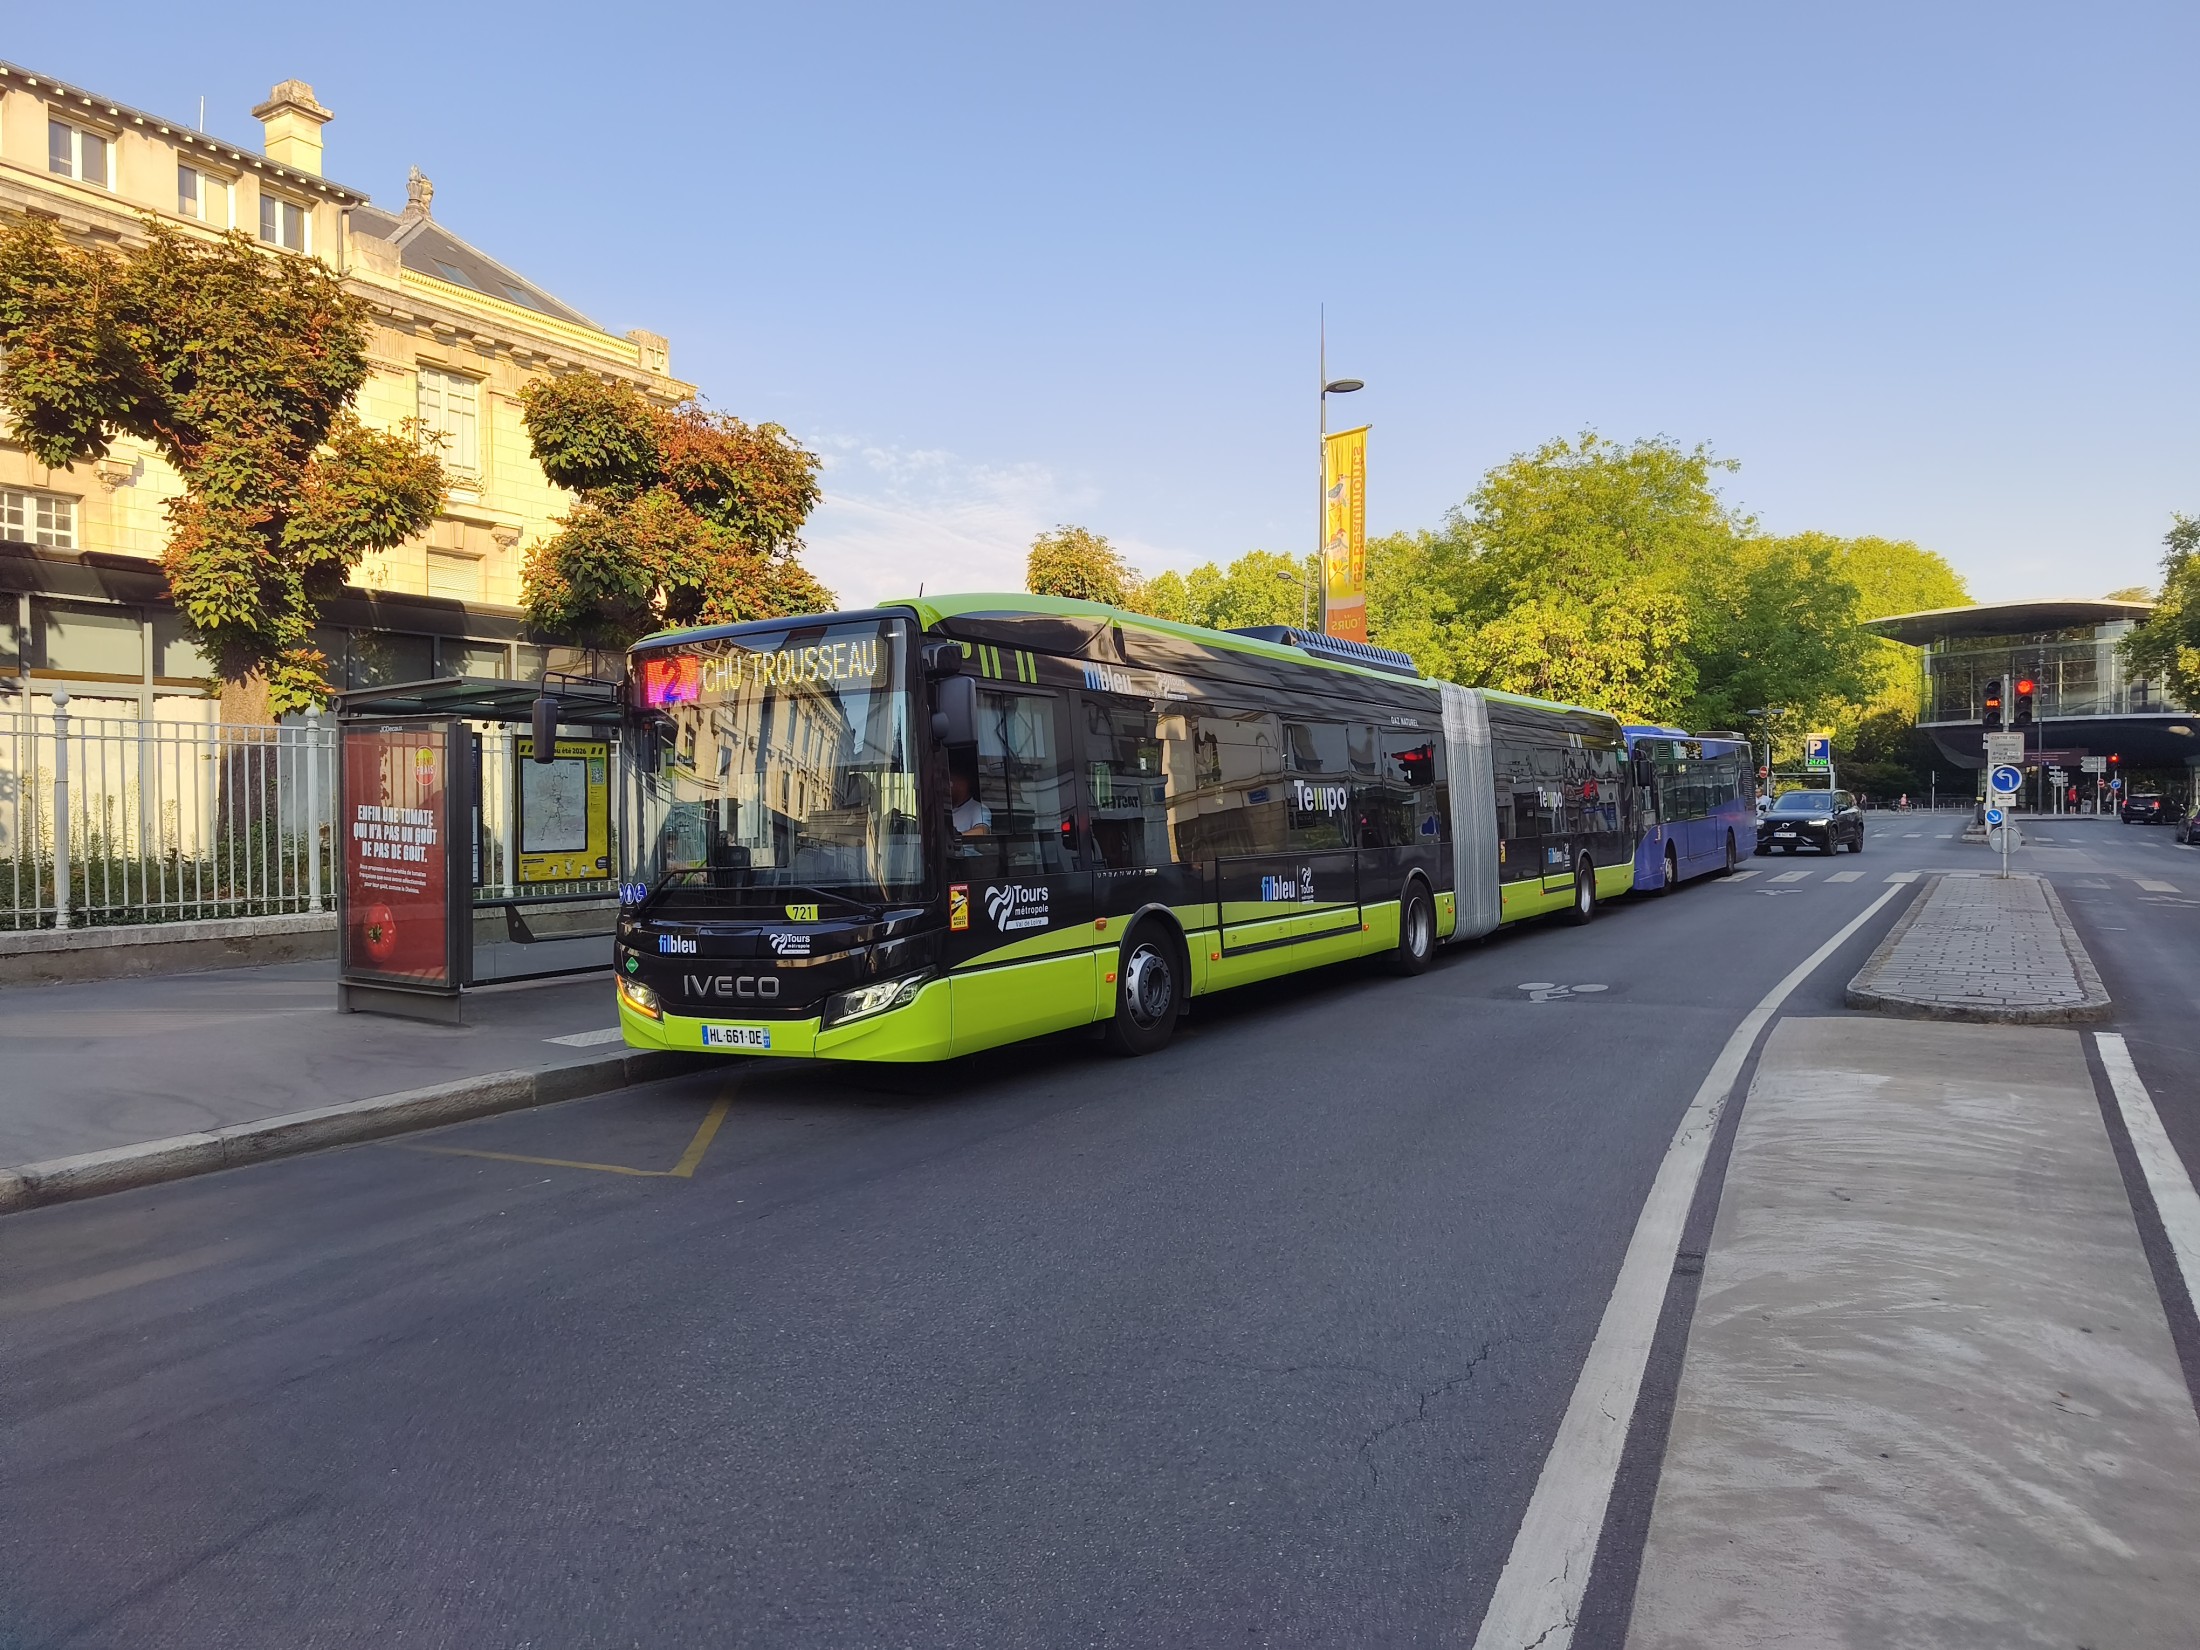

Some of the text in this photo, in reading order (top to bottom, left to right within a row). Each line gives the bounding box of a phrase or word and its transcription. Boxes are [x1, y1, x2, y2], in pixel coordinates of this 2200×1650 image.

[661, 639, 878, 701] 2 CHU TROUSSEAU
[572, 747, 587, 755] 2026
[1809, 740, 1822, 755] P
[1294, 780, 1347, 817] Tempo
[357, 804, 434, 826] ENFIN UNE TOMATE
[353, 822, 368, 840] QUI
[384, 825, 399, 841] PAS
[401, 826, 413, 842] UN
[362, 841, 372, 857] DE
[373, 842, 389, 858] PAS
[391, 844, 402, 860] DE
[1013, 885, 1049, 904] Tours
[1261, 875, 1296, 902] filbleu
[792, 906, 812, 920] 721
[1015, 903, 1049, 916] métropole
[659, 934, 697, 954] filbleu
[786, 933, 811, 943] Tours
[683, 974, 780, 998] IVECO
